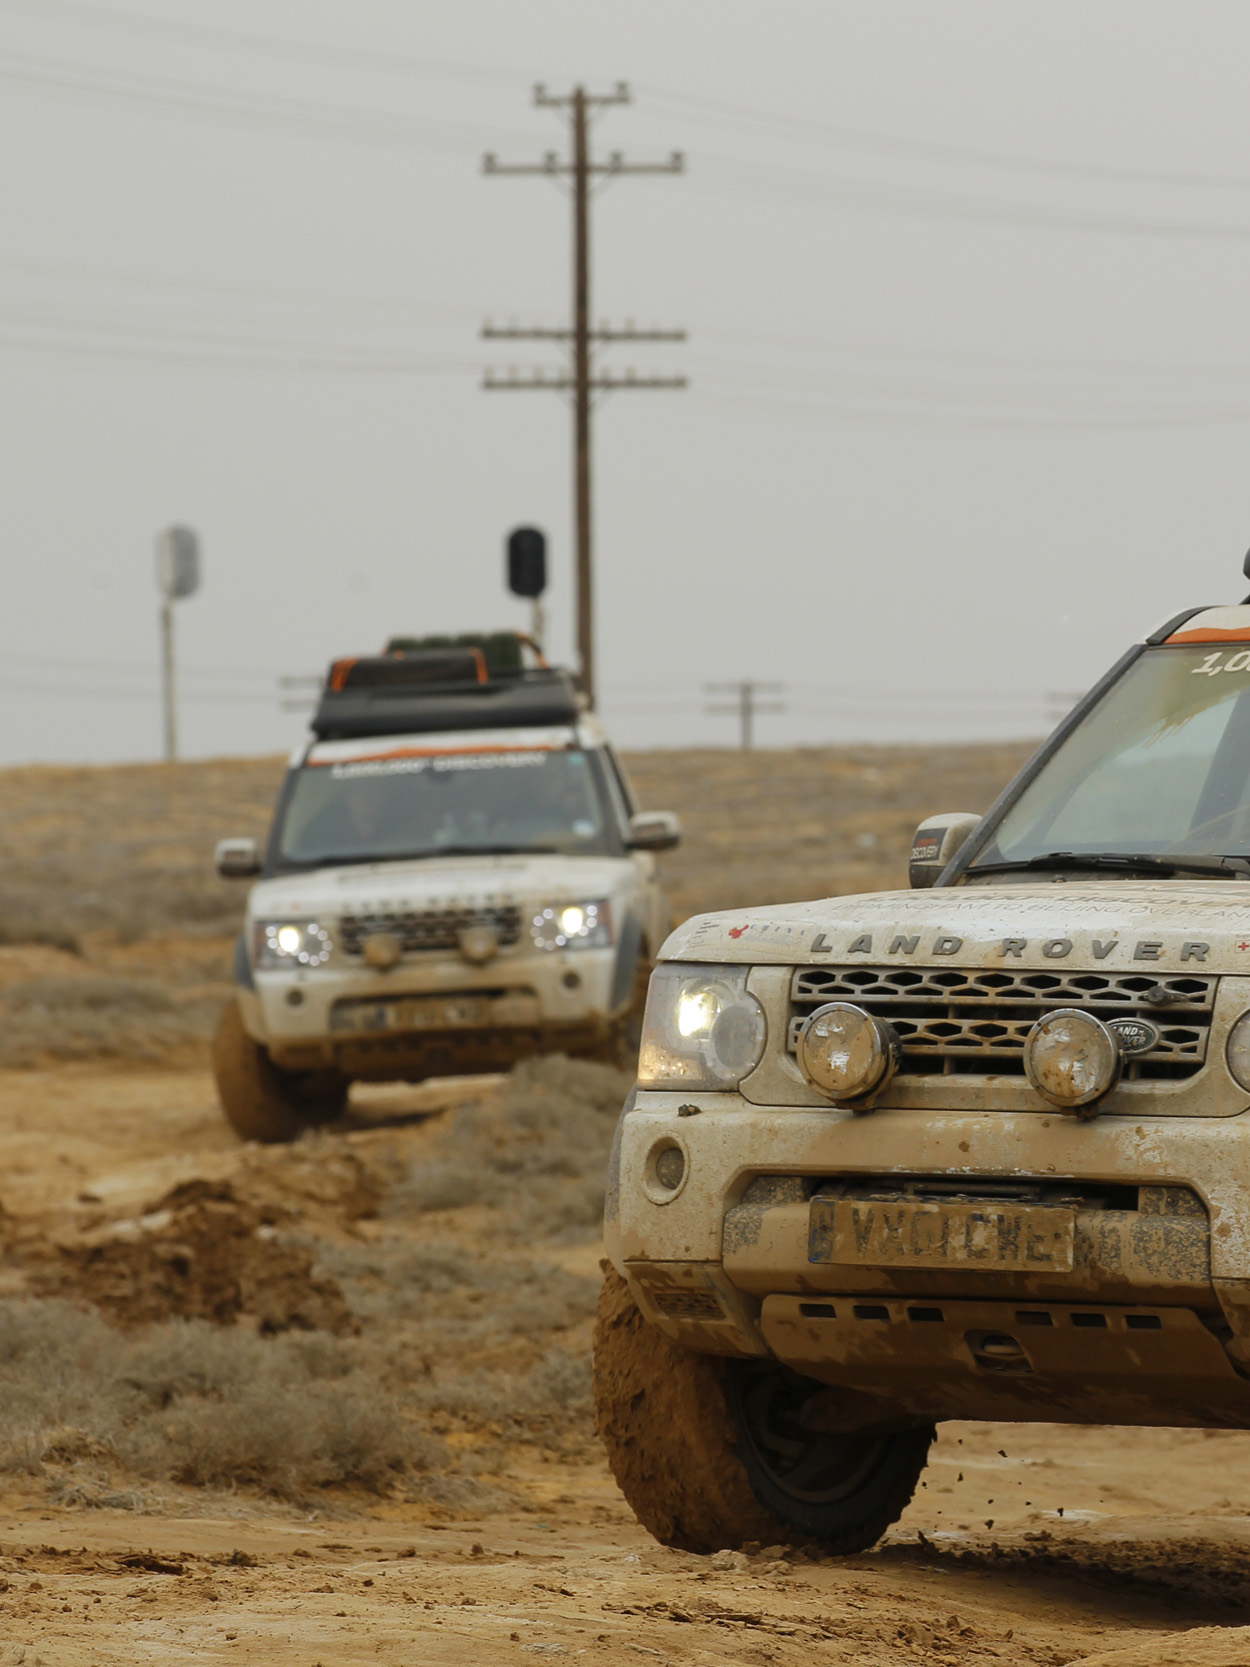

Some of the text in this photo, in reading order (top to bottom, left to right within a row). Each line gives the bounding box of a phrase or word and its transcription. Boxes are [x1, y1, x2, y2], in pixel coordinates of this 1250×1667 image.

[831, 901, 989, 912] BIRMINGHAM
[993, 902, 1022, 912] TO
[1026, 902, 1120, 914] BEIJING
[810, 933, 964, 956] LAND
[998, 937, 1211, 962] ROVER
